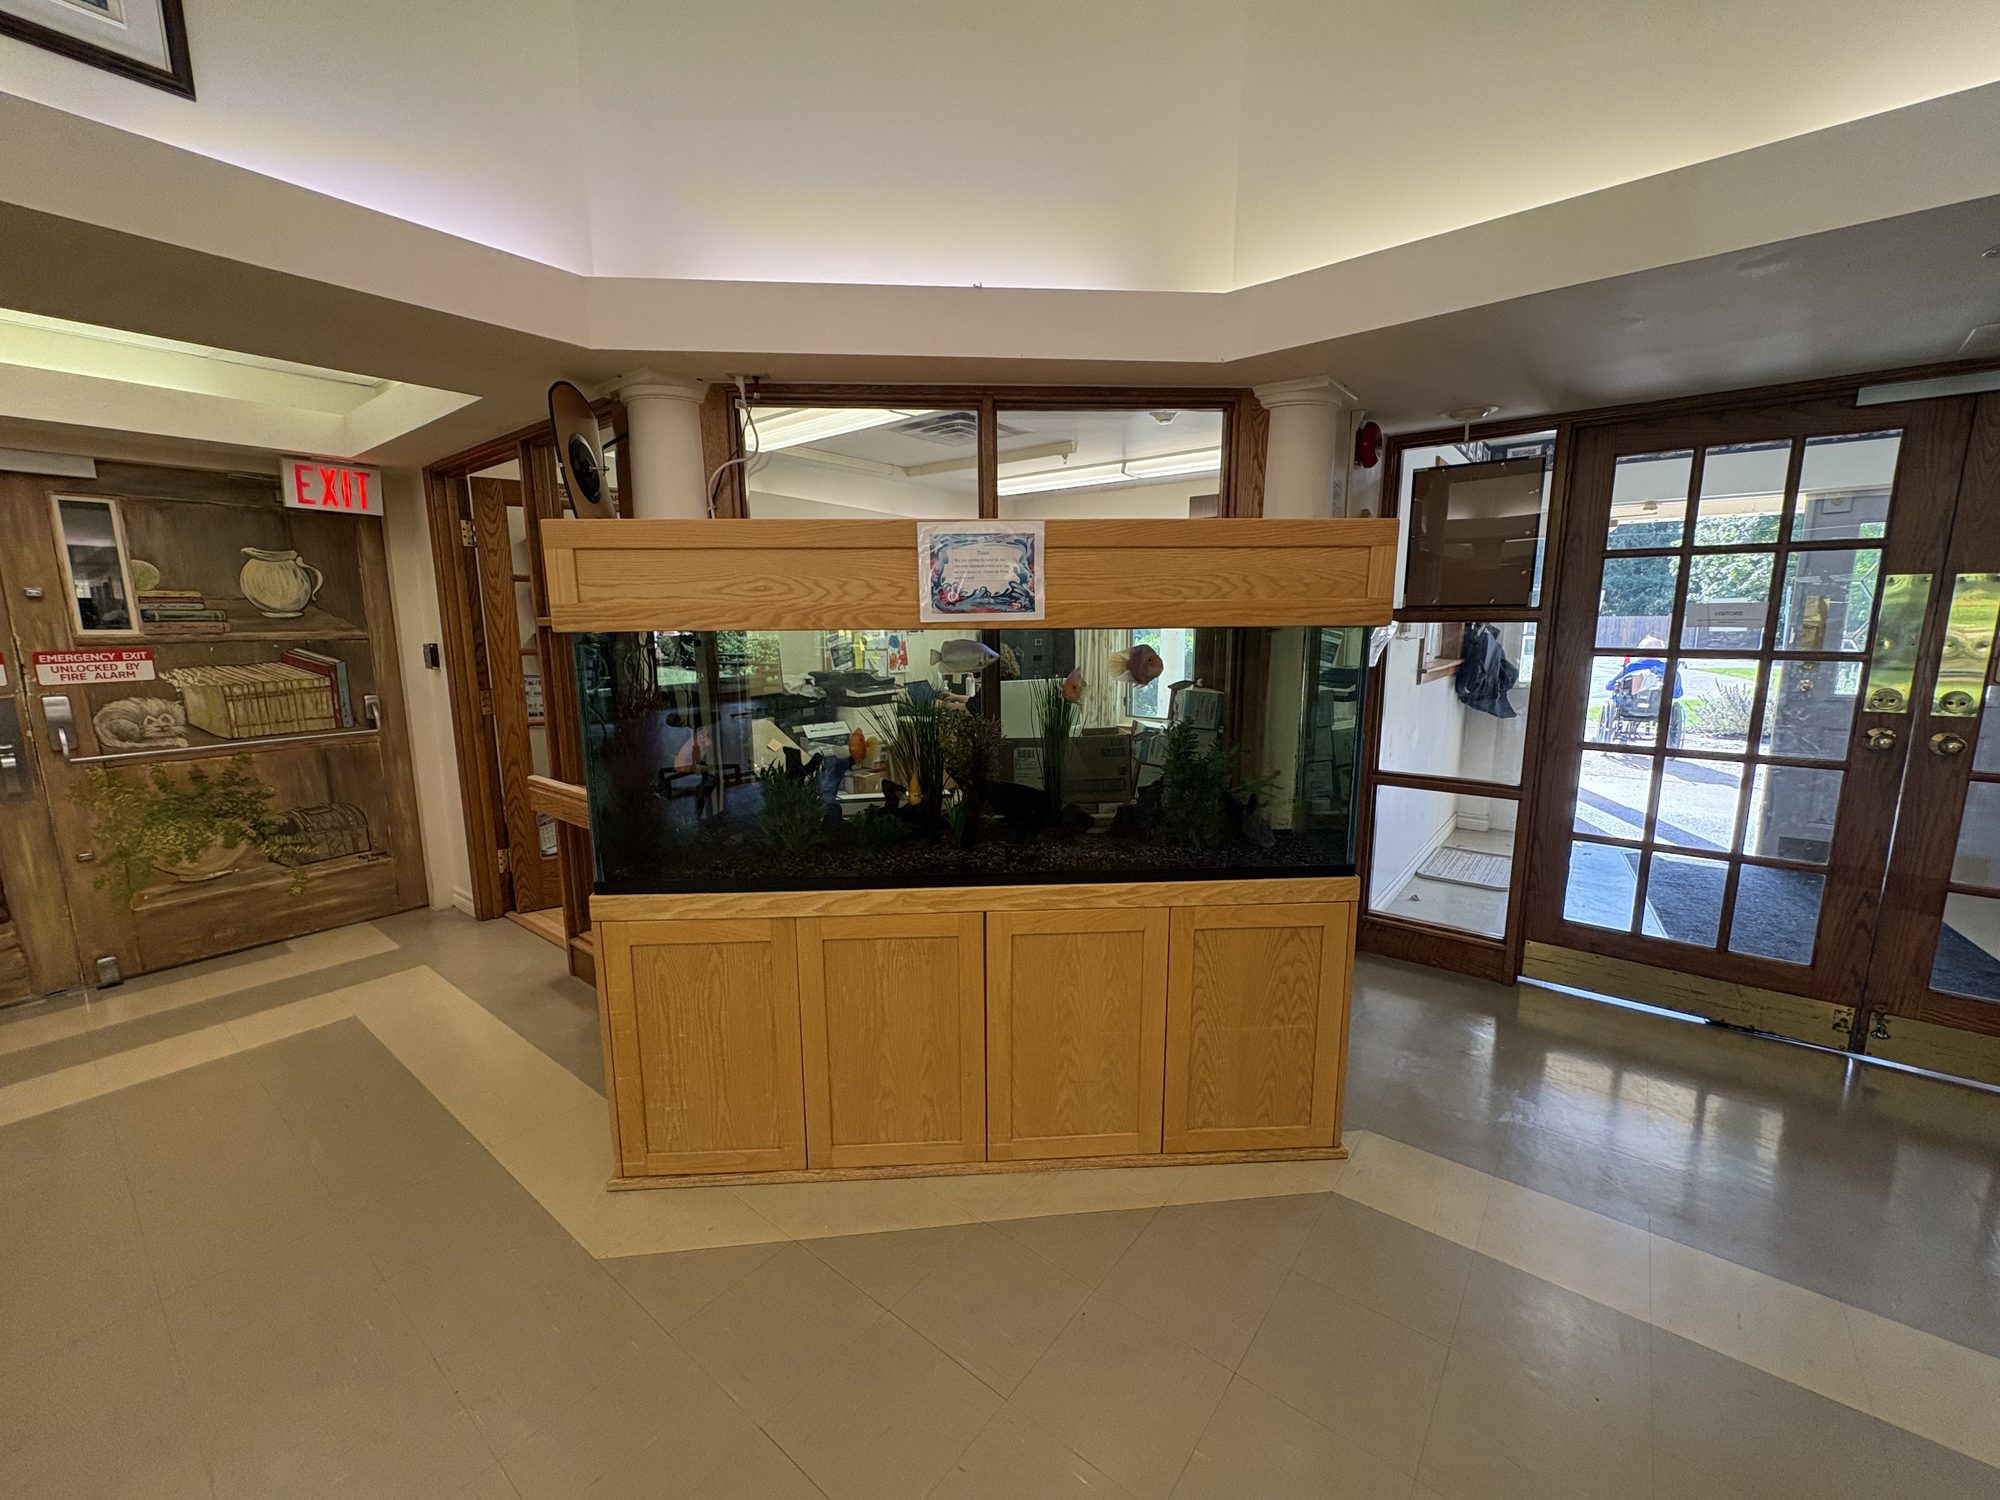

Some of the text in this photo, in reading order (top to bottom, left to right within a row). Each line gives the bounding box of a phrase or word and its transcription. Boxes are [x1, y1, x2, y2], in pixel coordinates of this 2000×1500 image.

[294, 463, 370, 511] EXIT
[38, 651, 147, 663] EMERGENCY EXIT
[50, 662, 140, 674] UNLOCKED BY
[60, 670, 136, 681] FIRE ALARM
